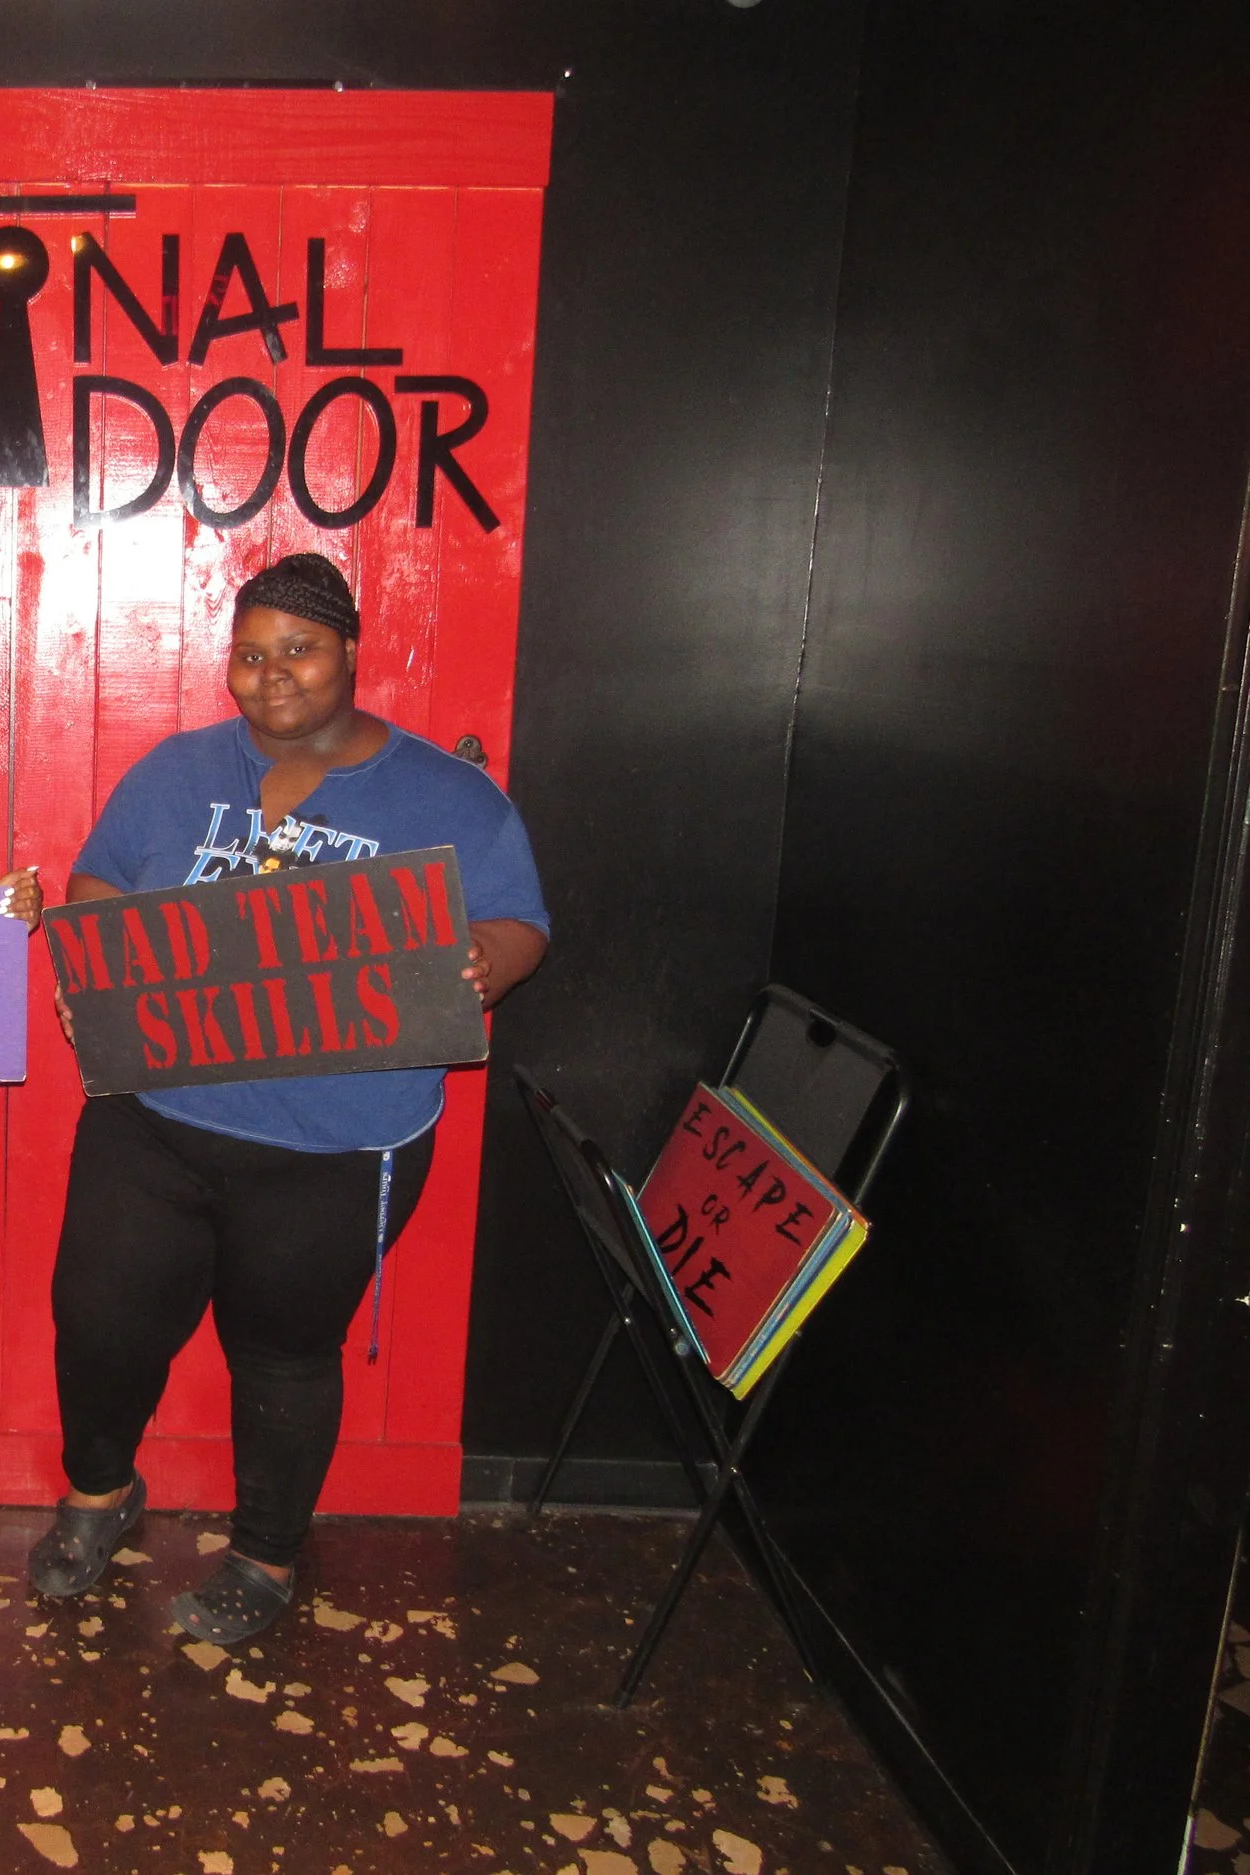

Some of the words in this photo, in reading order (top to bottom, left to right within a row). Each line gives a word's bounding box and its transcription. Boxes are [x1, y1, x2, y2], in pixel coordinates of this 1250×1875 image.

[73, 376, 501, 534] DOOR
[51, 900, 210, 995] MAD
[237, 862, 458, 969] TEAM
[135, 964, 401, 1070] SKILLS
[683, 1102, 814, 1246] ESCAPE
[701, 1194, 730, 1235] OR
[656, 1204, 735, 1318] DIE
